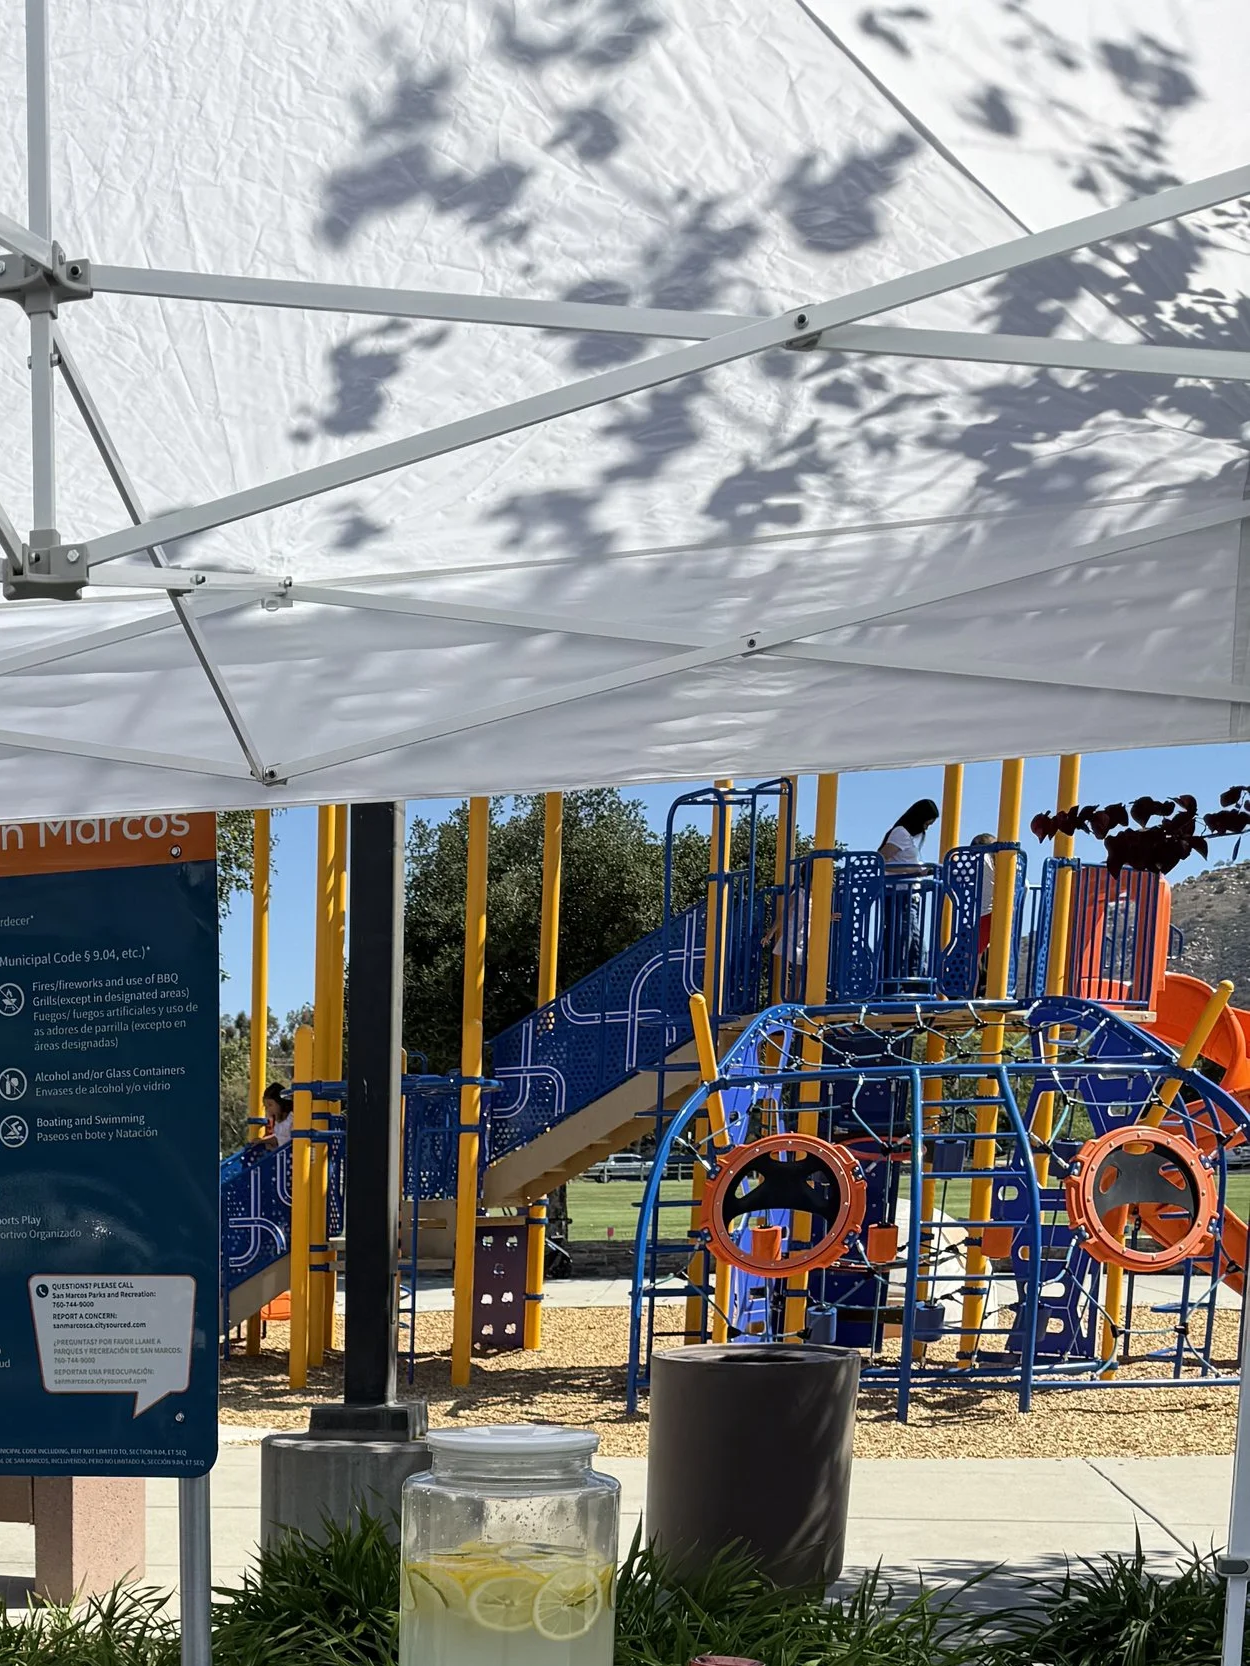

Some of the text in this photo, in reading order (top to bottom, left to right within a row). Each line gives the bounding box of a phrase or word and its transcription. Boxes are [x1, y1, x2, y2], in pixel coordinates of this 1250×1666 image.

[39, 813, 190, 848] Marcos
[0, 952, 51, 969] Municipal
[53, 950, 81, 964] Code
[83, 951, 90, 962] §
[92, 949, 119, 964] 9.04,
[32, 973, 178, 993] Fires/fireworks and use of BBQ
[32, 988, 189, 1009] Grills(except in designated areas)
[34, 1064, 185, 1082] Alcohol and/or Glass Containers
[35, 1080, 170, 1097] Envases de alcohol y/o vidrio
[36, 1113, 145, 1129] Boating and Swimming
[21, 1213, 41, 1227] Play
[51, 1282, 92, 1290] QUESTIONS?
[120, 1290, 156, 1298] Recreation:
[52, 1321, 146, 1330] sanmarcosca.citysourced.com
